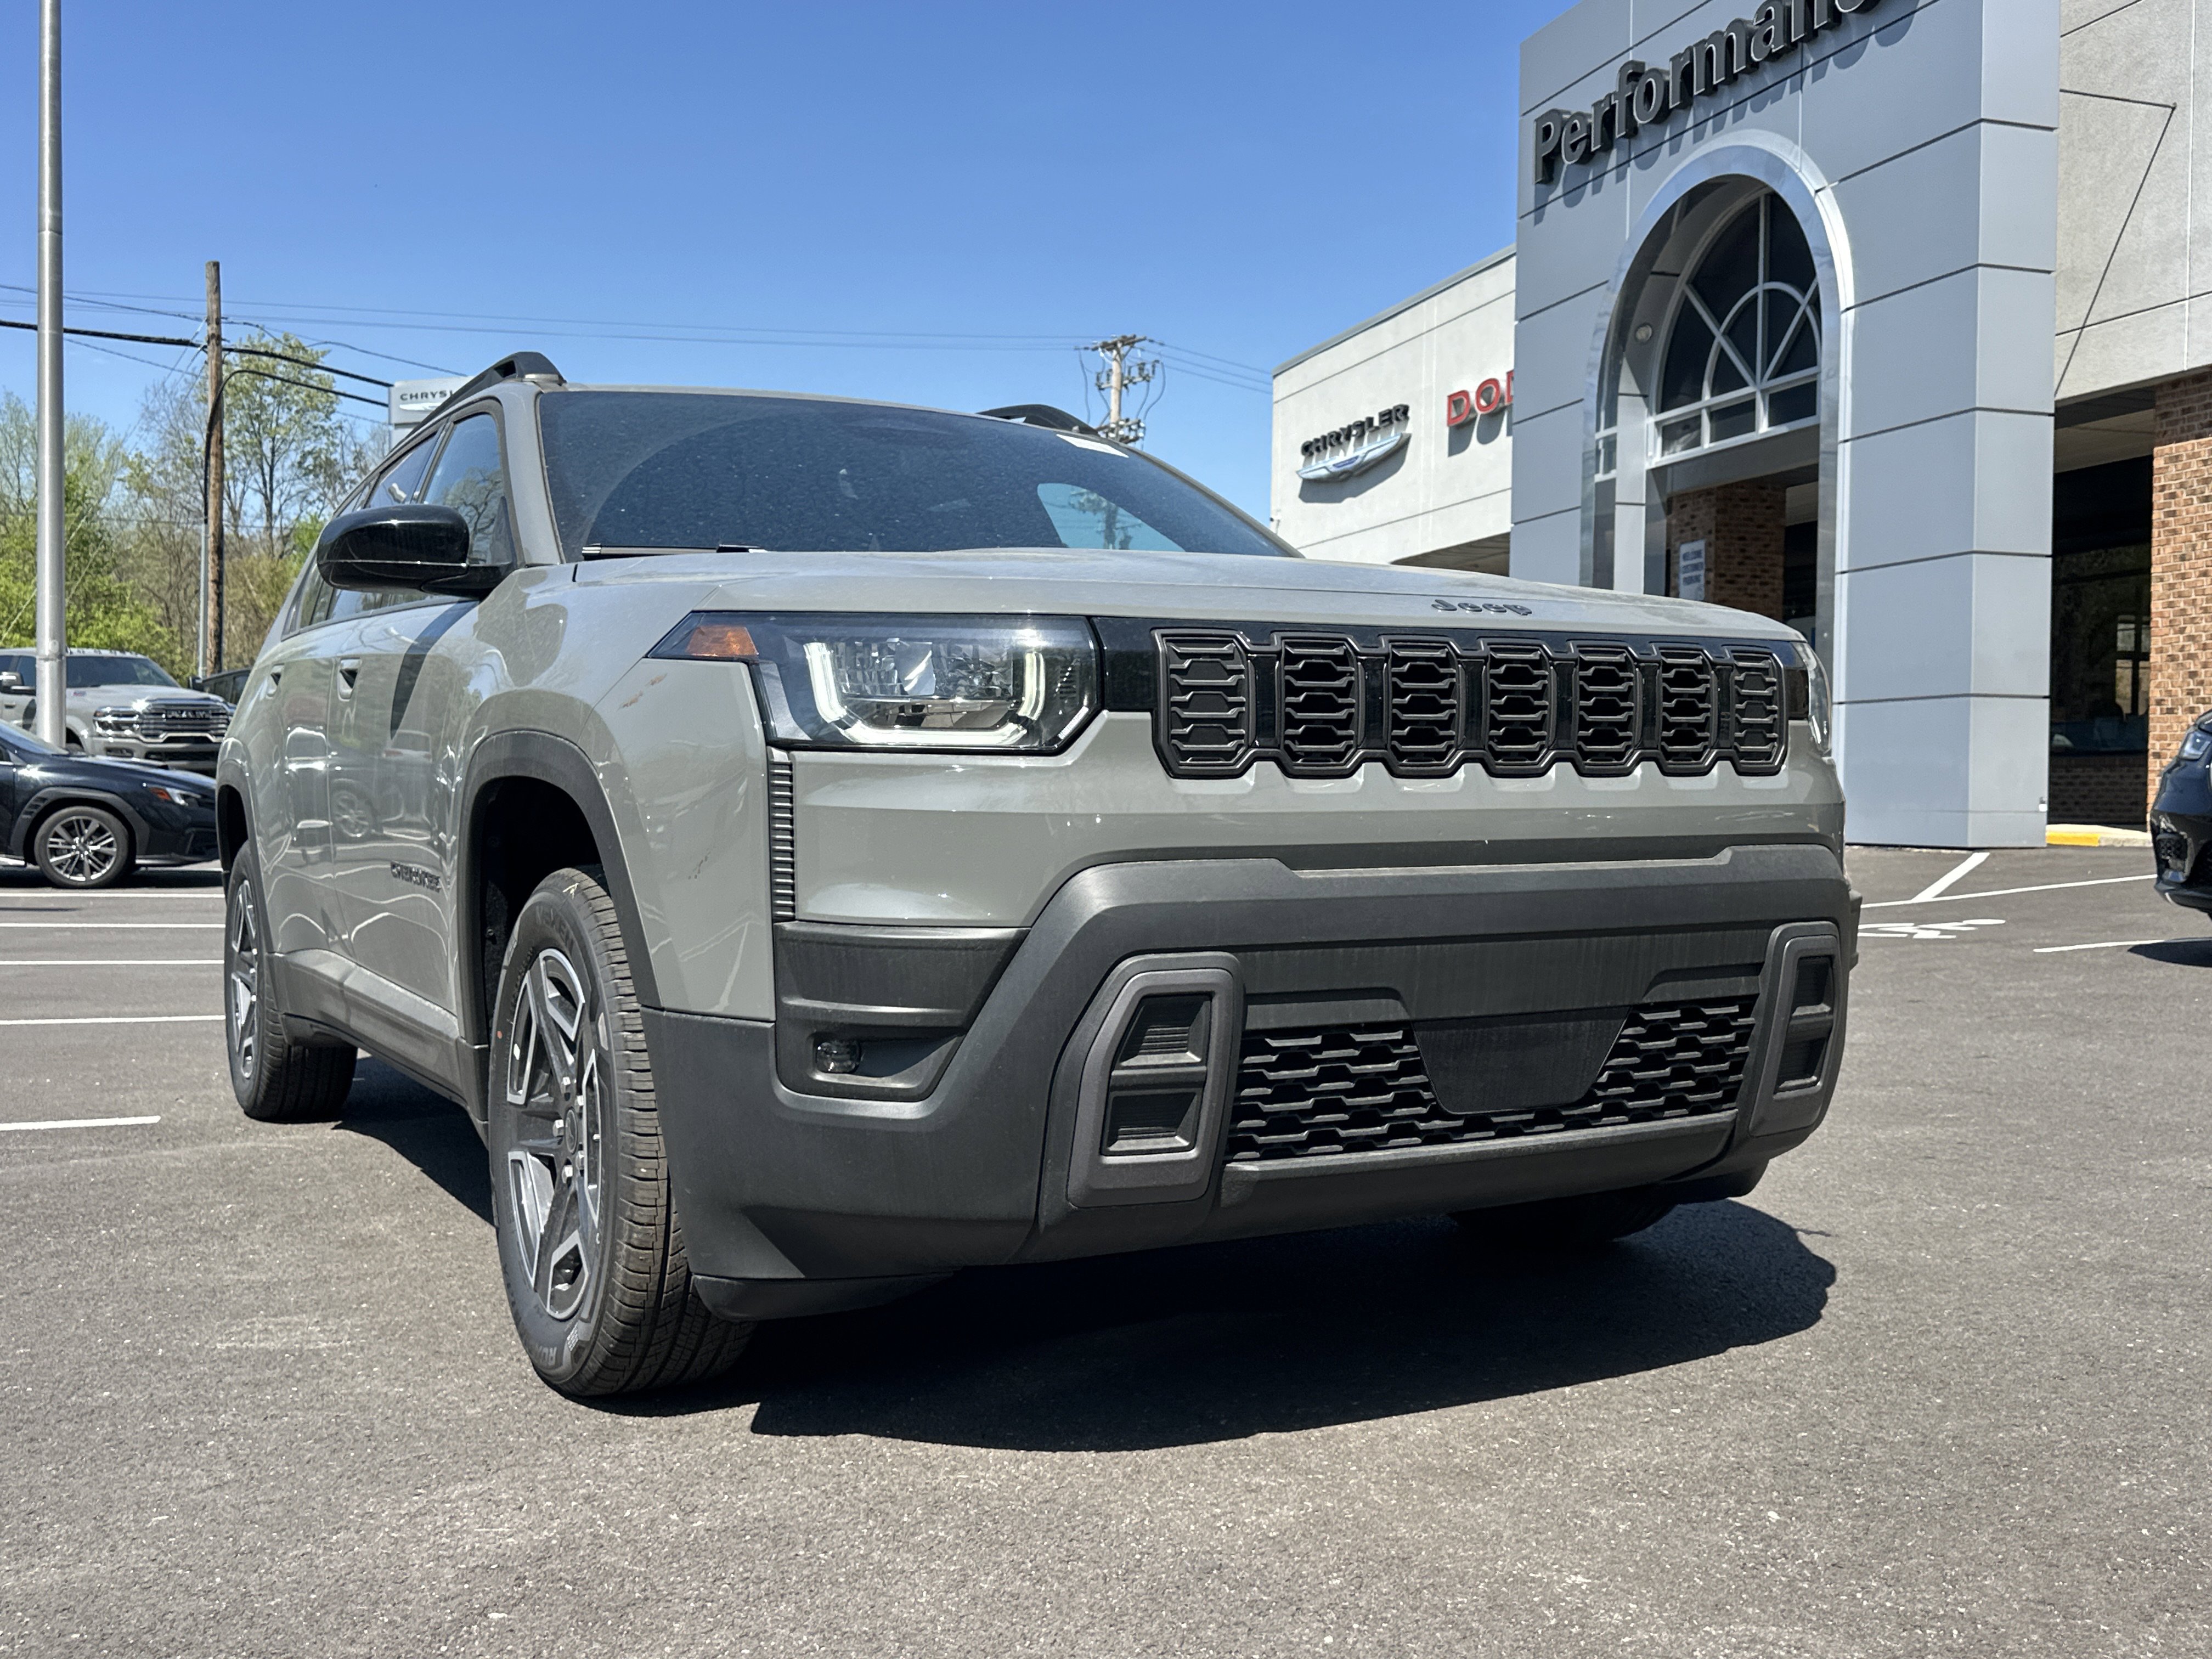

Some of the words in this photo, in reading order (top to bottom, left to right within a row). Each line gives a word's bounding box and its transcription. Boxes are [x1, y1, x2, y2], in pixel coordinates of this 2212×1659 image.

[1534, 0, 1882, 184] Performan
[1301, 403, 1410, 457] CHRYSLER
[1431, 599, 1533, 616] Jeep
